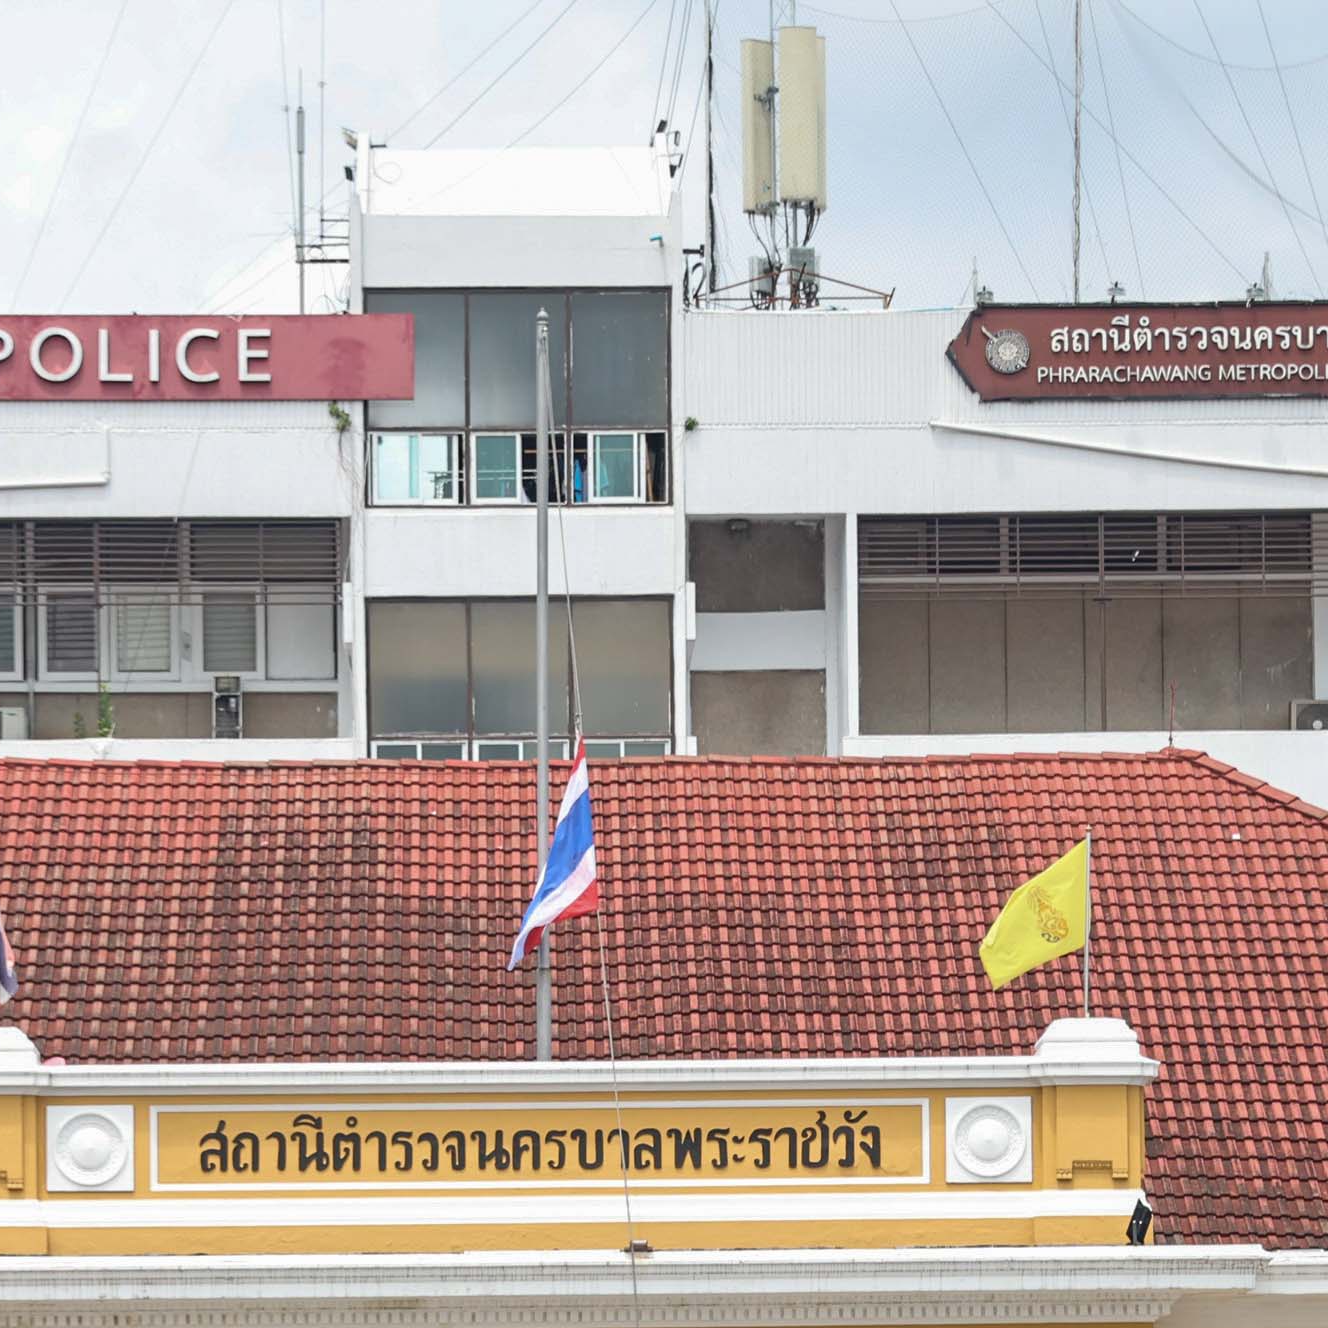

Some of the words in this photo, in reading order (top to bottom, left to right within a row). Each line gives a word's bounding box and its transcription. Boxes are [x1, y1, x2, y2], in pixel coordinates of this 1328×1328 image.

[1036, 364, 1212, 384] PHRARACHAWANG
[197, 1108, 885, 1176] สถานีตำรวจนครบาลพระราชวัง
